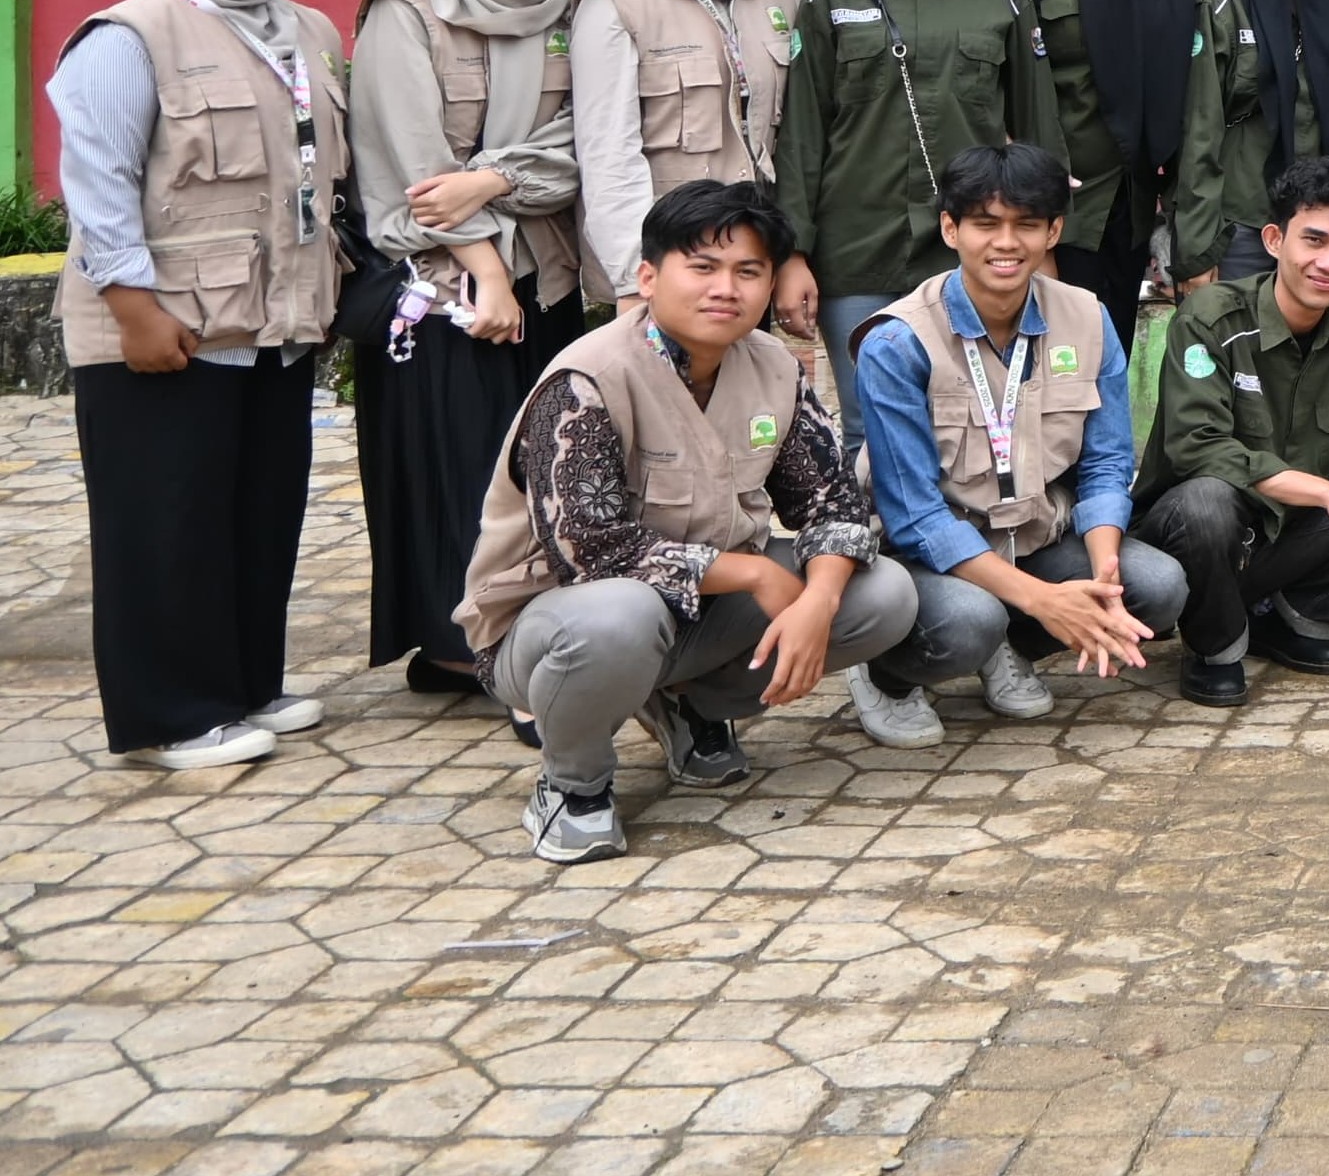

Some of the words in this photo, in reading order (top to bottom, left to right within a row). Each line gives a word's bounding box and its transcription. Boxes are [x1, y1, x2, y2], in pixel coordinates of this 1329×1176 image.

[974, 367, 985, 386] KKN
[980, 387, 992, 408] 2025
[1005, 384, 1016, 405] KKN
